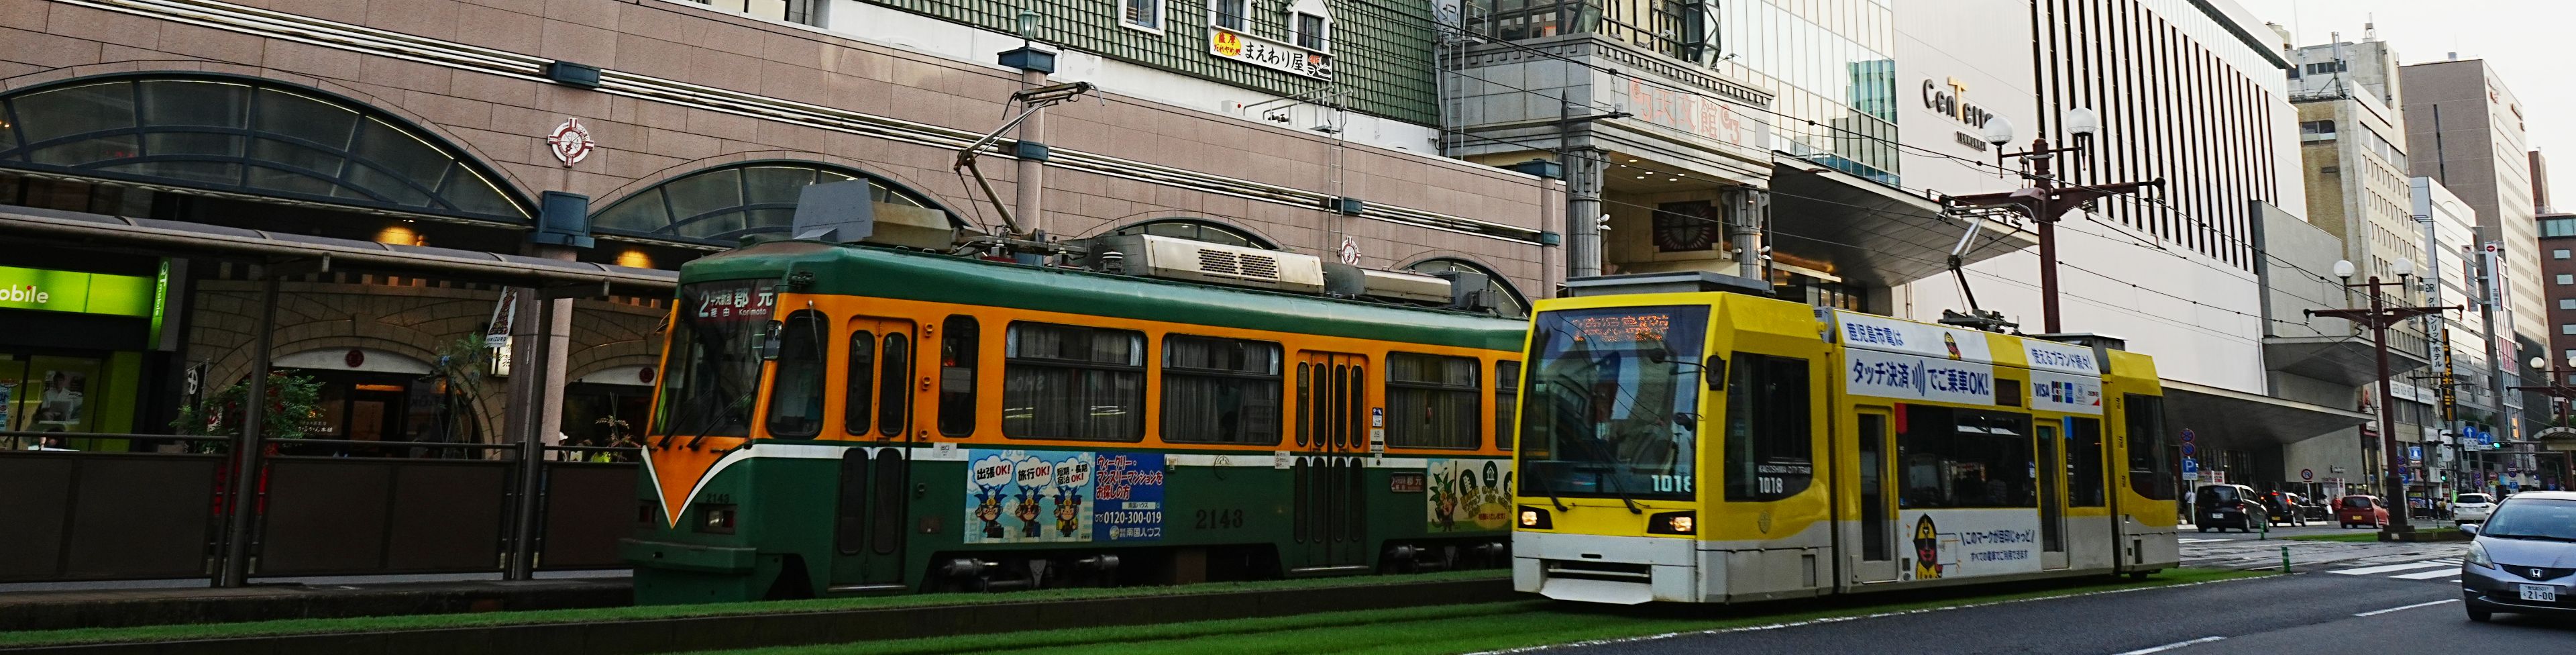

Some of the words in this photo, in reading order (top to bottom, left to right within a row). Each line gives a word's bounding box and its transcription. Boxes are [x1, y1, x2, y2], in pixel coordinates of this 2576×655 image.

[1245, 41, 1304, 72] まえわり屋
[1308, 54, 1321, 65] 4F
[1654, 88, 1717, 139] 天文館
[699, 289, 710, 317] 2
[734, 287, 773, 308] 郡元
[1846, 321, 1904, 347] 鹿児島市電は
[2428, 297, 2443, 368] グリンリッチホテル
[1854, 358, 1909, 389] タッチ決済
[1927, 368, 1989, 396] でご乗車OK!
[2033, 383, 2051, 398] VISA
[977, 464, 1011, 481] 出張OK!
[1018, 465, 1051, 482] 旅行OK!
[2186, 460, 2195, 471] P
[1058, 472, 1084, 485] 宿泊OK!
[1096, 470, 1163, 485] マンスリーマンションを
[1758, 476, 1783, 494] 1018
[1095, 484, 1131, 501] お探しの方
[1104, 511, 1162, 523] 0120-300-019
[1195, 508, 1243, 530] 2143
[1126, 527, 1161, 538] 南国ハウス
[2528, 591, 2554, 601] 21-00
